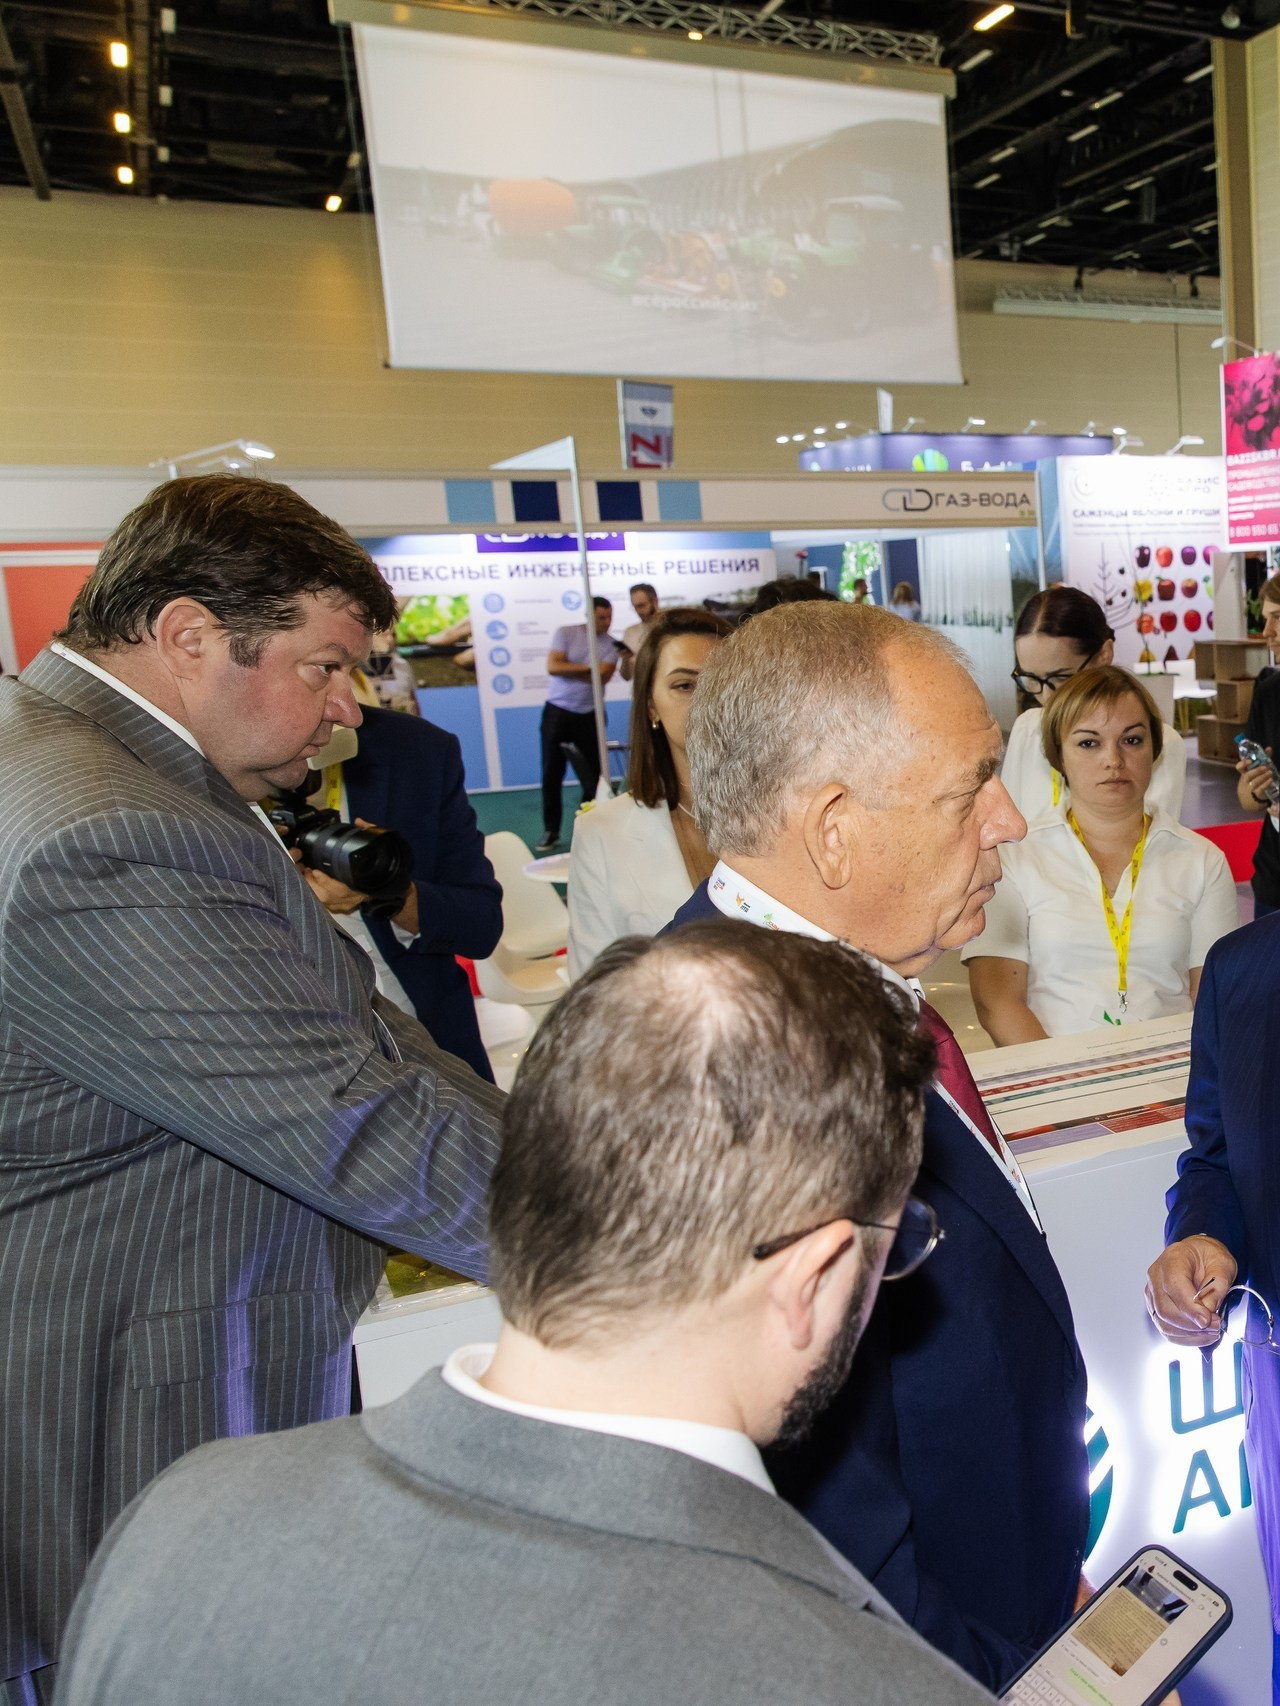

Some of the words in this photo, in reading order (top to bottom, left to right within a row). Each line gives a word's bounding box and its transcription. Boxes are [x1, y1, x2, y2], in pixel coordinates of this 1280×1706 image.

[934, 492, 1031, 508] ГАЗ-ВОДА
[508, 560, 658, 579] ИНЖЕНЕРНЫЕ
[664, 557, 760, 575] РЕШЕНИЯ
